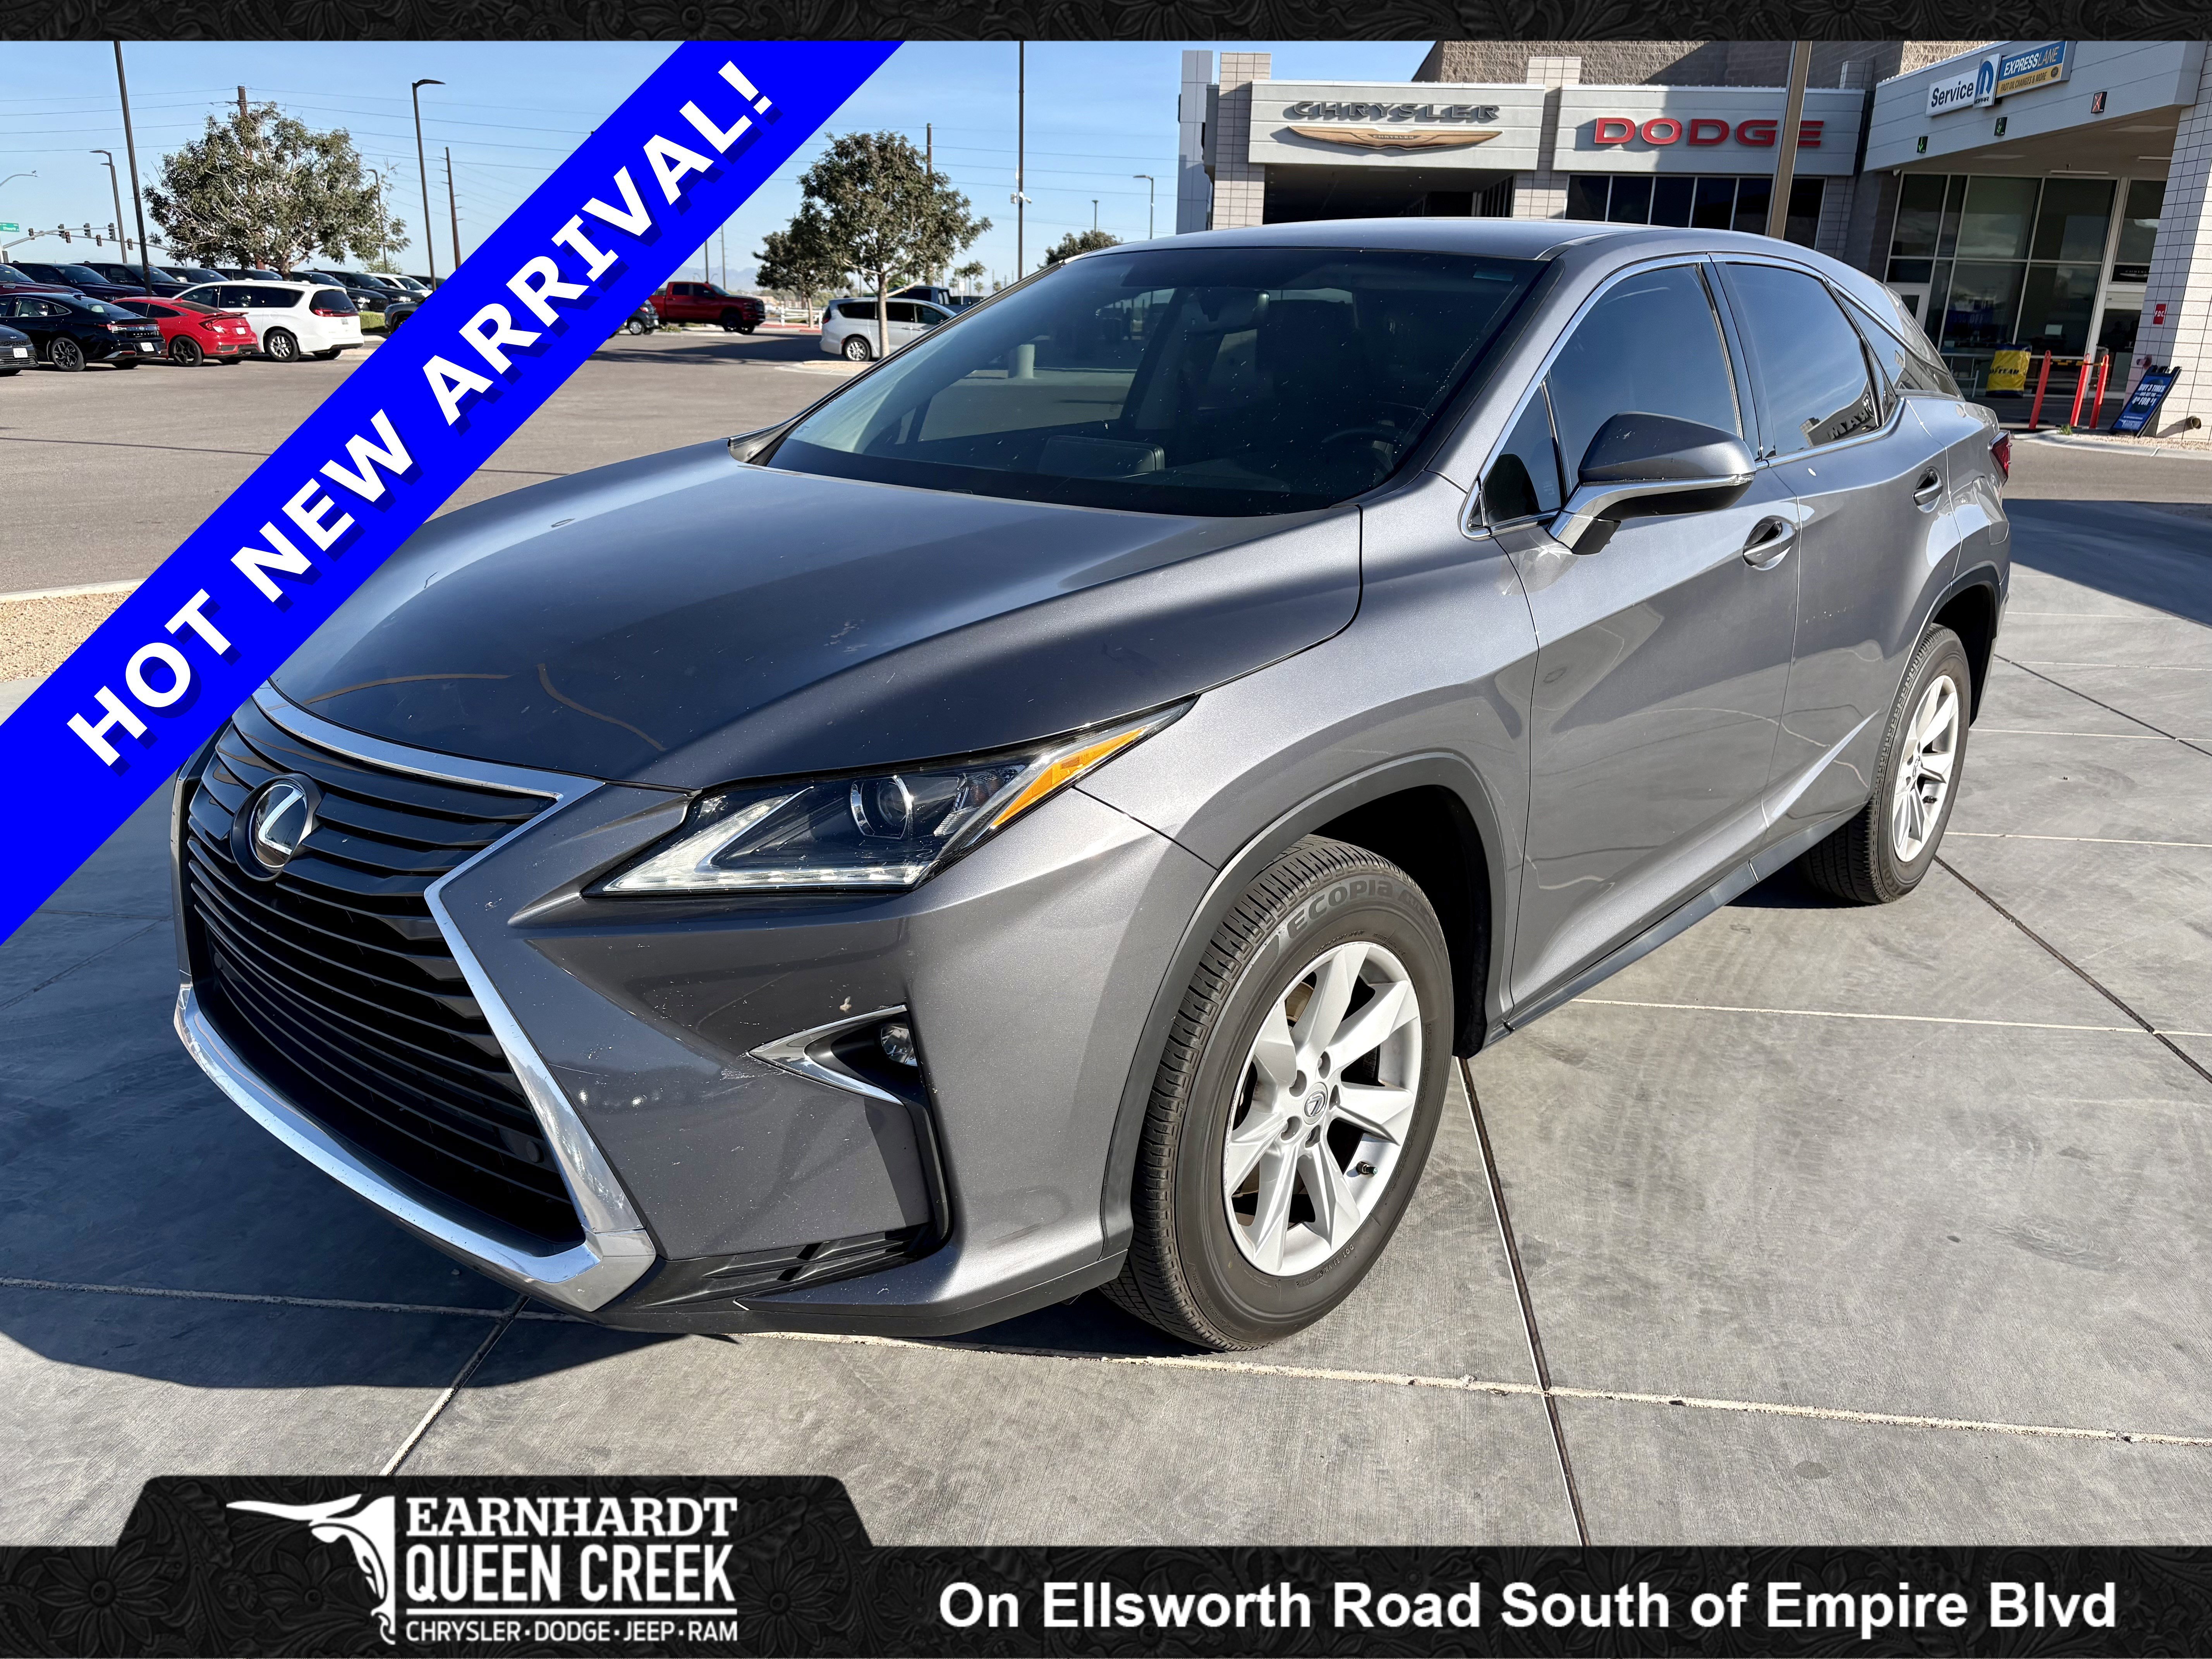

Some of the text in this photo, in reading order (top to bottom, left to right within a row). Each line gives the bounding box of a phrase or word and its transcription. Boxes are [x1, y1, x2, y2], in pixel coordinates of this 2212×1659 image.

[1931, 81, 1973, 107] Service
[1294, 101, 1500, 119] CHRYSLER
[1594, 117, 1824, 147] DODGE
[1342, 1244, 1354, 1258] DOT
